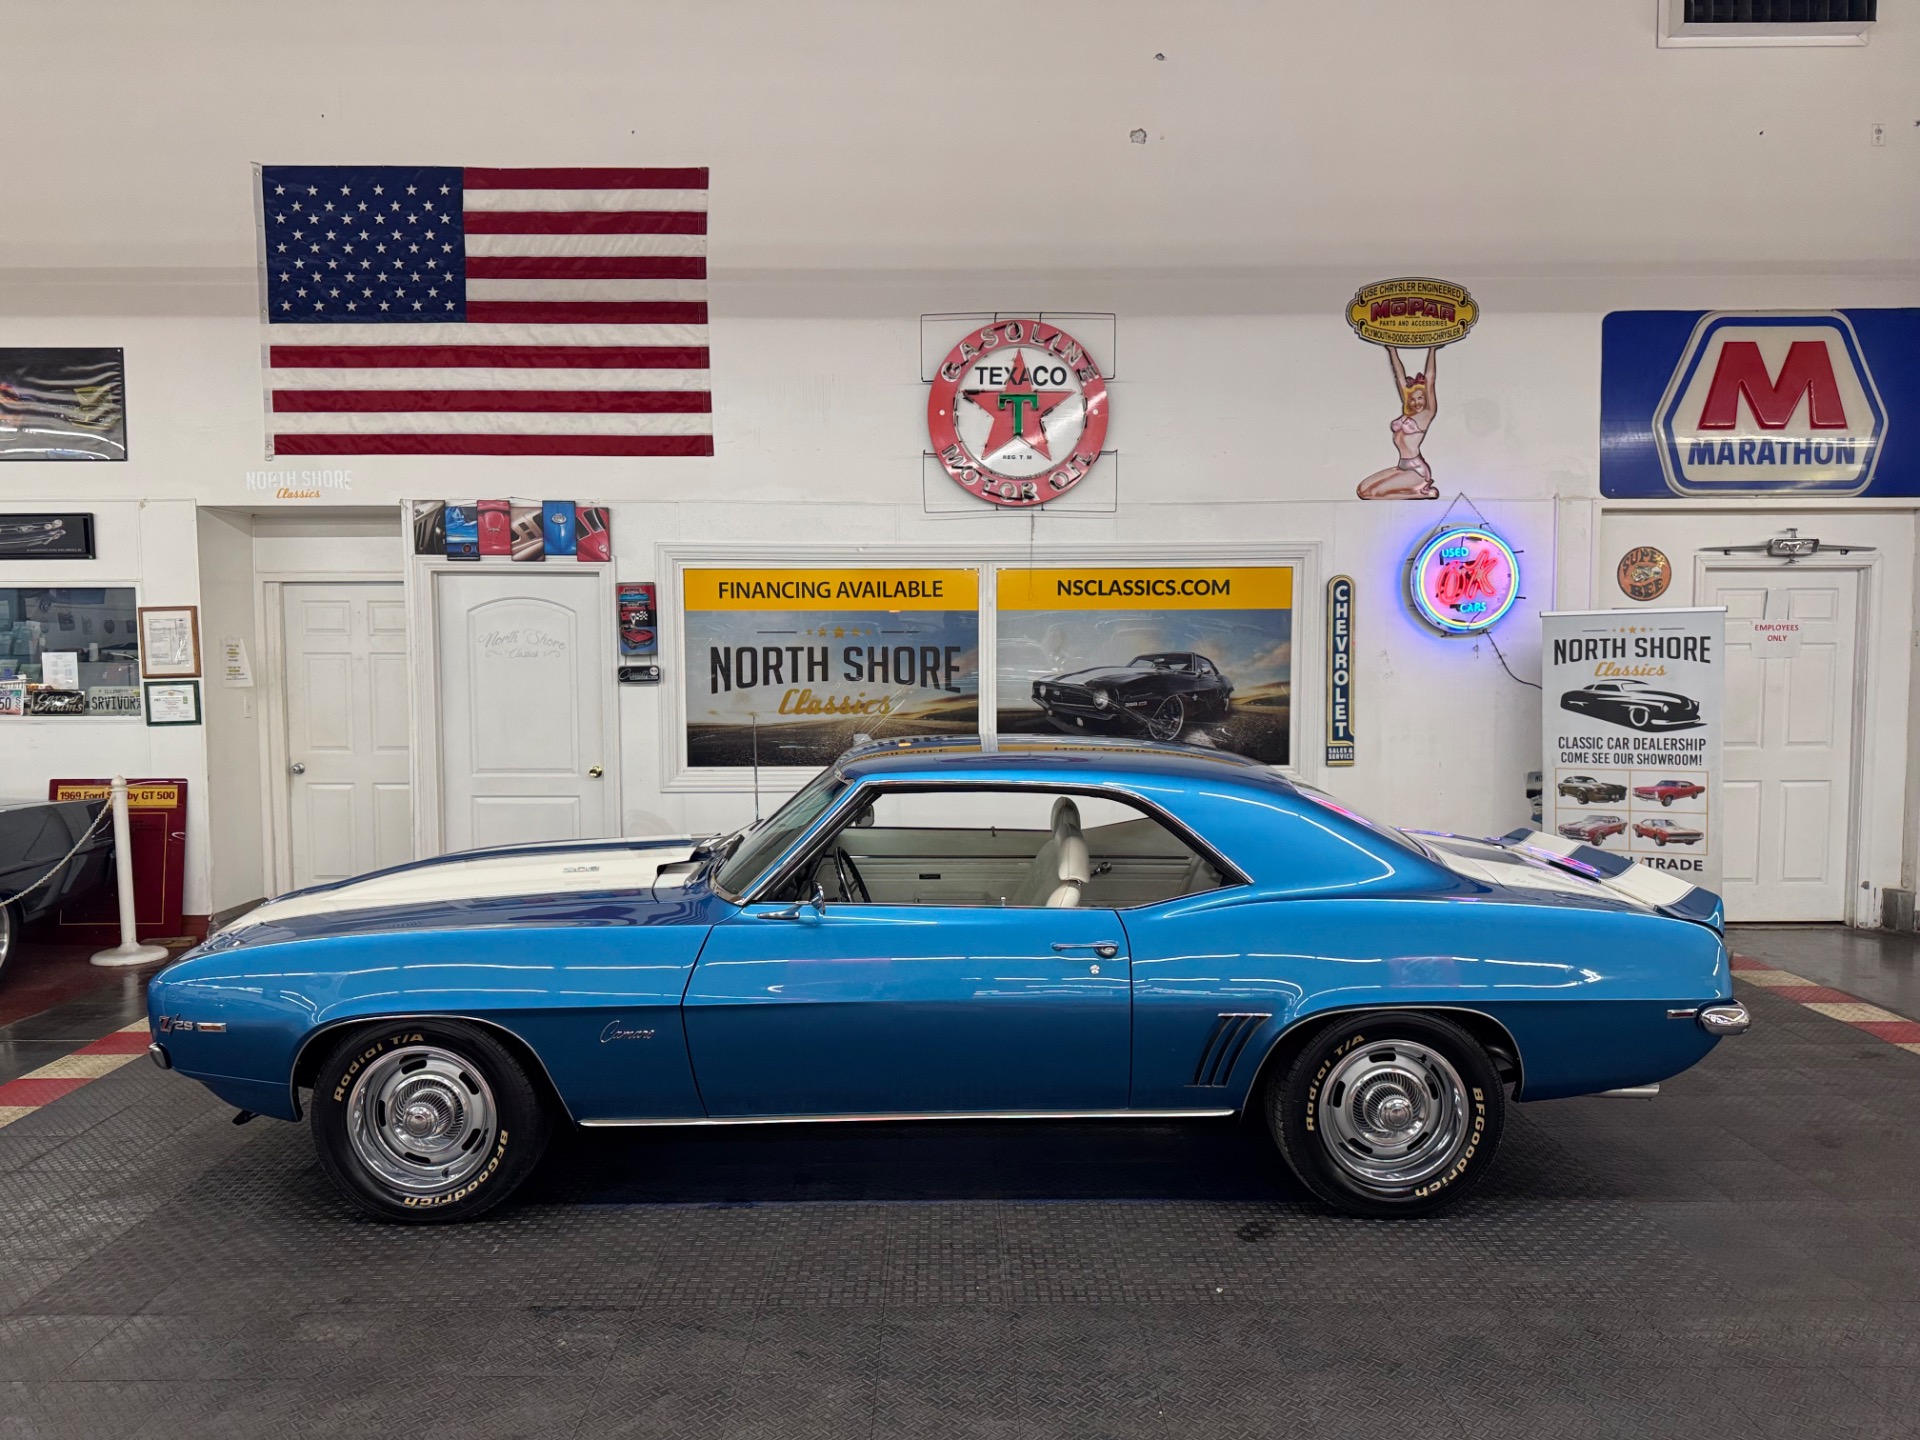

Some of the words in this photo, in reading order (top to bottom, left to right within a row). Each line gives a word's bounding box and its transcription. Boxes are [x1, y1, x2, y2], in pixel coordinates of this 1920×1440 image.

[1364, 287, 1378, 298] USE
[1380, 282, 1415, 295] CHRYSLER
[1417, 282, 1461, 298] ENGINEERED
[941, 321, 1099, 386] GASOLINE
[975, 366, 1067, 387] TEXACO
[1687, 437, 1856, 466] MARATHON
[245, 470, 297, 492] NORTH
[301, 470, 353, 490] SHORE
[942, 444, 1041, 503] MOTOR
[1048, 451, 1096, 490] OIL
[276, 487, 321, 499] Classics
[1441, 547, 1469, 558] USED
[1057, 579, 1231, 596] NSCLASSICS.COM
[1437, 549, 1498, 606] OK
[1629, 578, 1664, 598] BEE
[718, 581, 832, 599] FINANCING
[836, 580, 944, 598] AVAILABLE
[1460, 602, 1487, 613] CARS
[1754, 624, 1799, 632] EMPLOYEES
[1766, 634, 1788, 642] ONLY
[1333, 585, 1349, 738] CHEVROLET
[1553, 637, 1626, 666] NORTH
[1634, 636, 1712, 664] SHORE
[710, 646, 829, 695] NORTH
[843, 646, 962, 694] SHORE
[1593, 661, 1668, 678] Classics
[777, 688, 896, 716] Classics
[1558, 736, 1604, 750] CLASSIC
[1607, 737, 1630, 750] CAR
[1633, 737, 1707, 751] DEALERSHIP
[1560, 752, 1591, 764] COME
[1592, 752, 1611, 764] SEE
[1613, 752, 1634, 765] OUR
[1636, 753, 1703, 766] SHOWROOM!
[60, 791, 82, 800] 1969
[84, 791, 105, 800] Ford
[106, 790, 138, 802] Sby
[141, 790, 155, 800] GT
[157, 790, 175, 800] 500
[600, 1019, 655, 1043] Camaro
[333, 1042, 383, 1102] Radial
[389, 1033, 425, 1046] T/A
[1305, 1058, 1332, 1132] Radial
[1334, 1034, 1366, 1056] T/A
[1414, 1087, 1486, 1198] BFGoodrich
[404, 1128, 509, 1208] BFGoodrich
